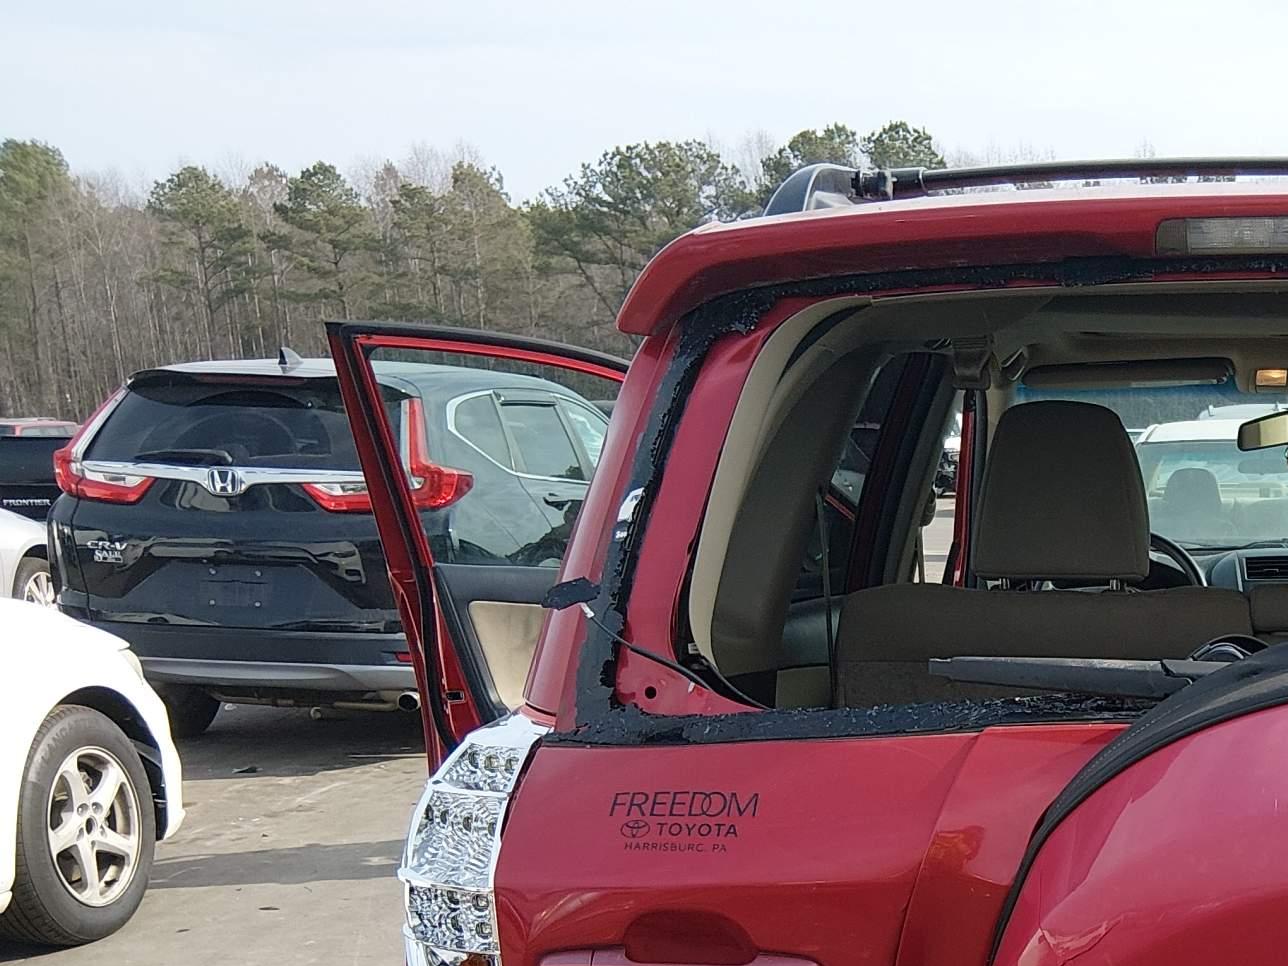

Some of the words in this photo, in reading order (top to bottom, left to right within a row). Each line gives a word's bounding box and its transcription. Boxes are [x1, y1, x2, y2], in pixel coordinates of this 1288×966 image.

[2, 498, 52, 507] FRONTIER
[87, 540, 129, 551] CR-V
[609, 791, 760, 818] FREEDOM
[656, 822, 738, 838] TOYOTA
[711, 842, 728, 853] PA
